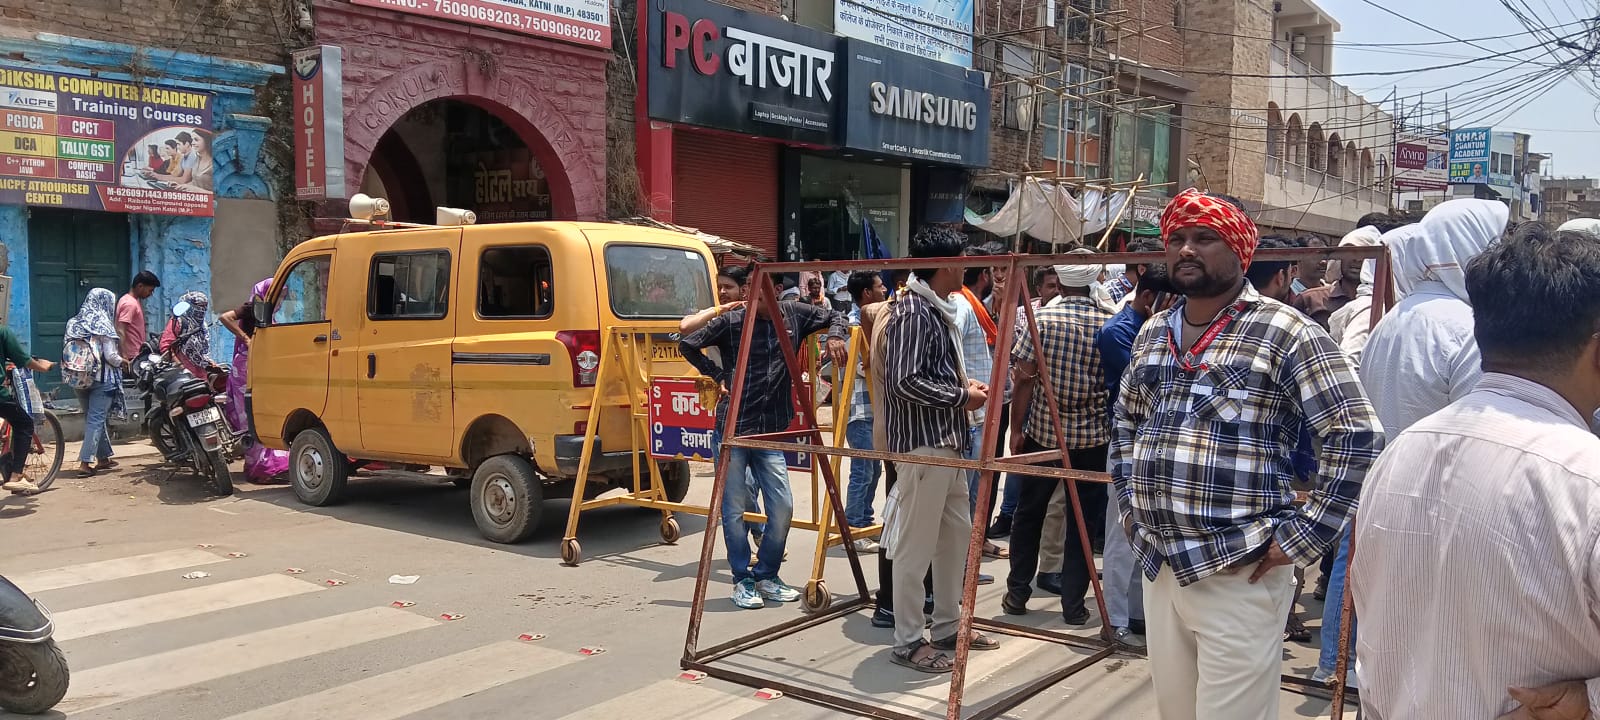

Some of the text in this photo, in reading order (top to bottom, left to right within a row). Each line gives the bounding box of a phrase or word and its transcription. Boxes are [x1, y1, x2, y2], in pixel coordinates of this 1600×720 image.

[577, 9, 604, 22] 483501
[663, 11, 836, 103] PC बाजार
[59, 77, 139, 101] COMPUTER
[142, 88, 207, 110] ACADEMY
[14, 96, 55, 108] AICPE
[871, 81, 977, 131] SAMSUNG
[72, 98, 202, 125] Training Courses
[755, 109, 769, 119] Laptop
[7, 114, 44, 130] PGDCA
[72, 120, 99, 136] CPCT
[302, 84, 315, 188] HOTEL
[1455, 132, 1486, 142] KHAN
[14, 137, 37, 151] DCA
[61, 141, 111, 158] TALLY GST
[1454, 141, 1486, 150] QUANTUM
[1454, 149, 1485, 159] ACADEMY
[22, 159, 45, 168] PYTHON
[68, 161, 104, 172] COMPUTER
[19, 167, 34, 175] JAVA
[474, 160, 513, 203] होटल
[28, 182, 90, 195] ATHOURISED
[25, 193, 63, 205] CENTER
[653, 385, 664, 452] STOP
